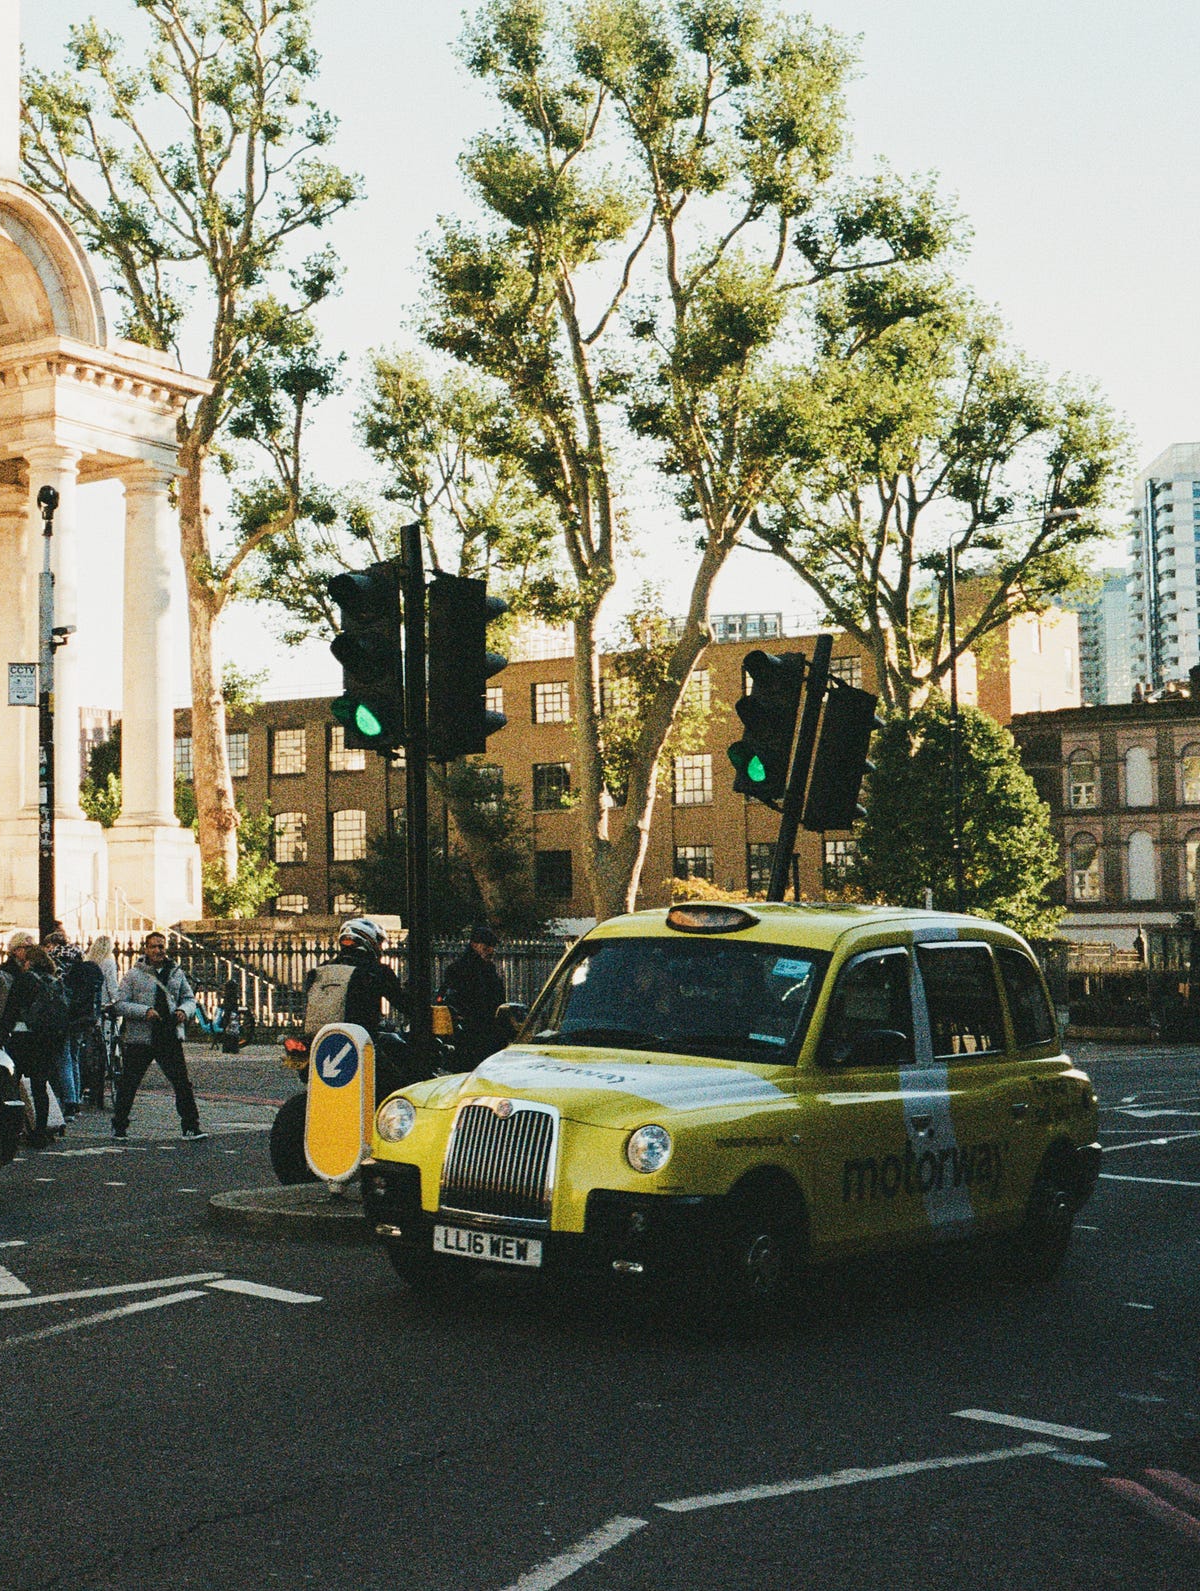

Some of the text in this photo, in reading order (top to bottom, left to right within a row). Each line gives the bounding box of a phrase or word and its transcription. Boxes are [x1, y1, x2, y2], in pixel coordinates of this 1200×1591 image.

[10, 666, 35, 674] CCTV
[842, 1139, 1004, 1204] motorway
[443, 1228, 529, 1262] LL16 WEW
